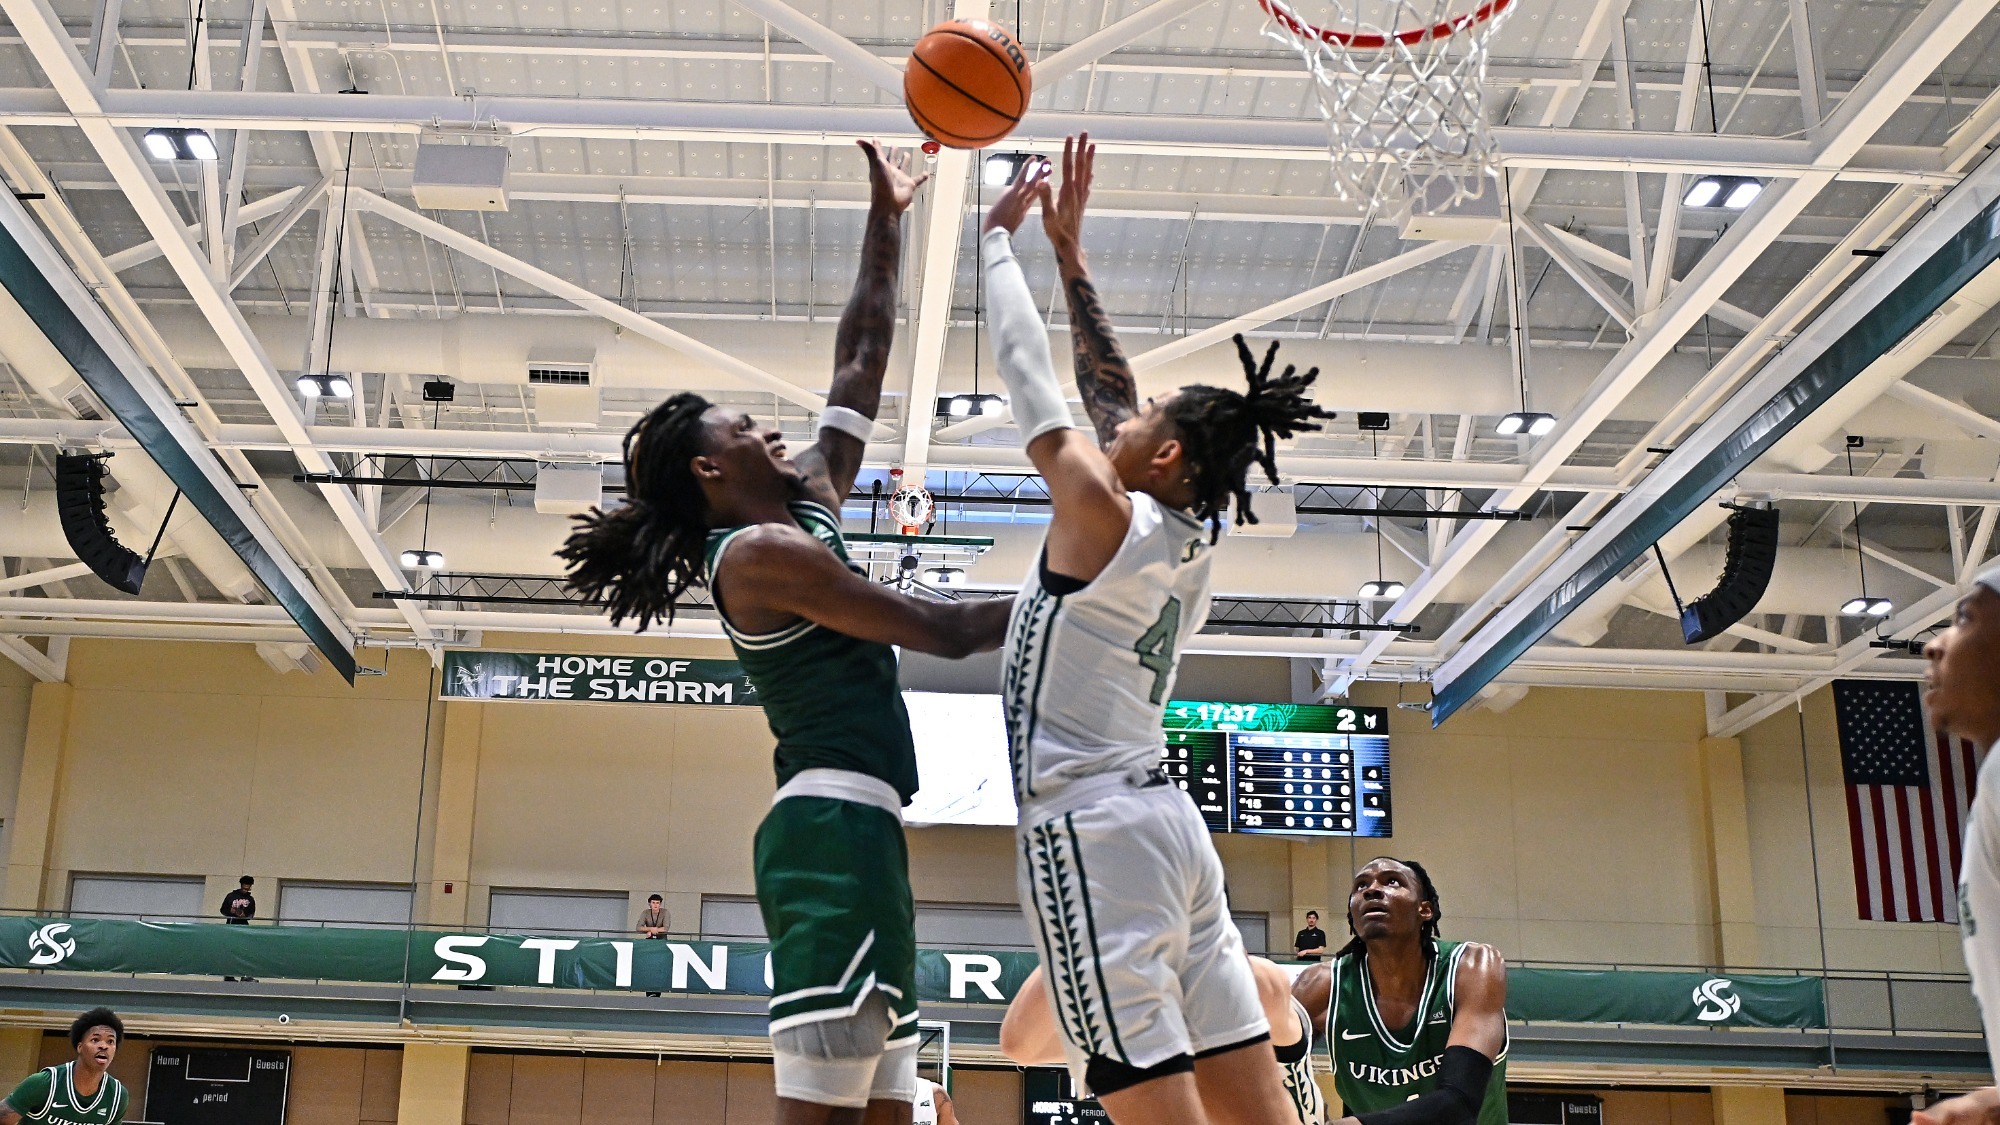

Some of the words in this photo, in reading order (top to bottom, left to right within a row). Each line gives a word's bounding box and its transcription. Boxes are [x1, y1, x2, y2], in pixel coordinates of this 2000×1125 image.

[1134, 595, 1181, 706] 4
[536, 656, 635, 677] HOME
[645, 659, 691, 678] OF
[491, 675, 576, 699] THE
[588, 678, 733, 704] SWARM
[1197, 704, 1258, 723] 17:37
[1336, 709, 1357, 731] 2
[1207, 764, 1216, 774] 4
[1284, 767, 1294, 778] 2
[1303, 768, 1312, 779] 2
[1368, 769, 1378, 779] 4
[1370, 796, 1378, 806] 1
[431, 935, 1006, 1000] STINR
[157, 1055, 180, 1066] Home
[256, 1059, 285, 1070] Guests
[203, 1092, 229, 1103] period
[1081, 1109, 1106, 1117] PERIOD
[1568, 1103, 1598, 1114] Guests
